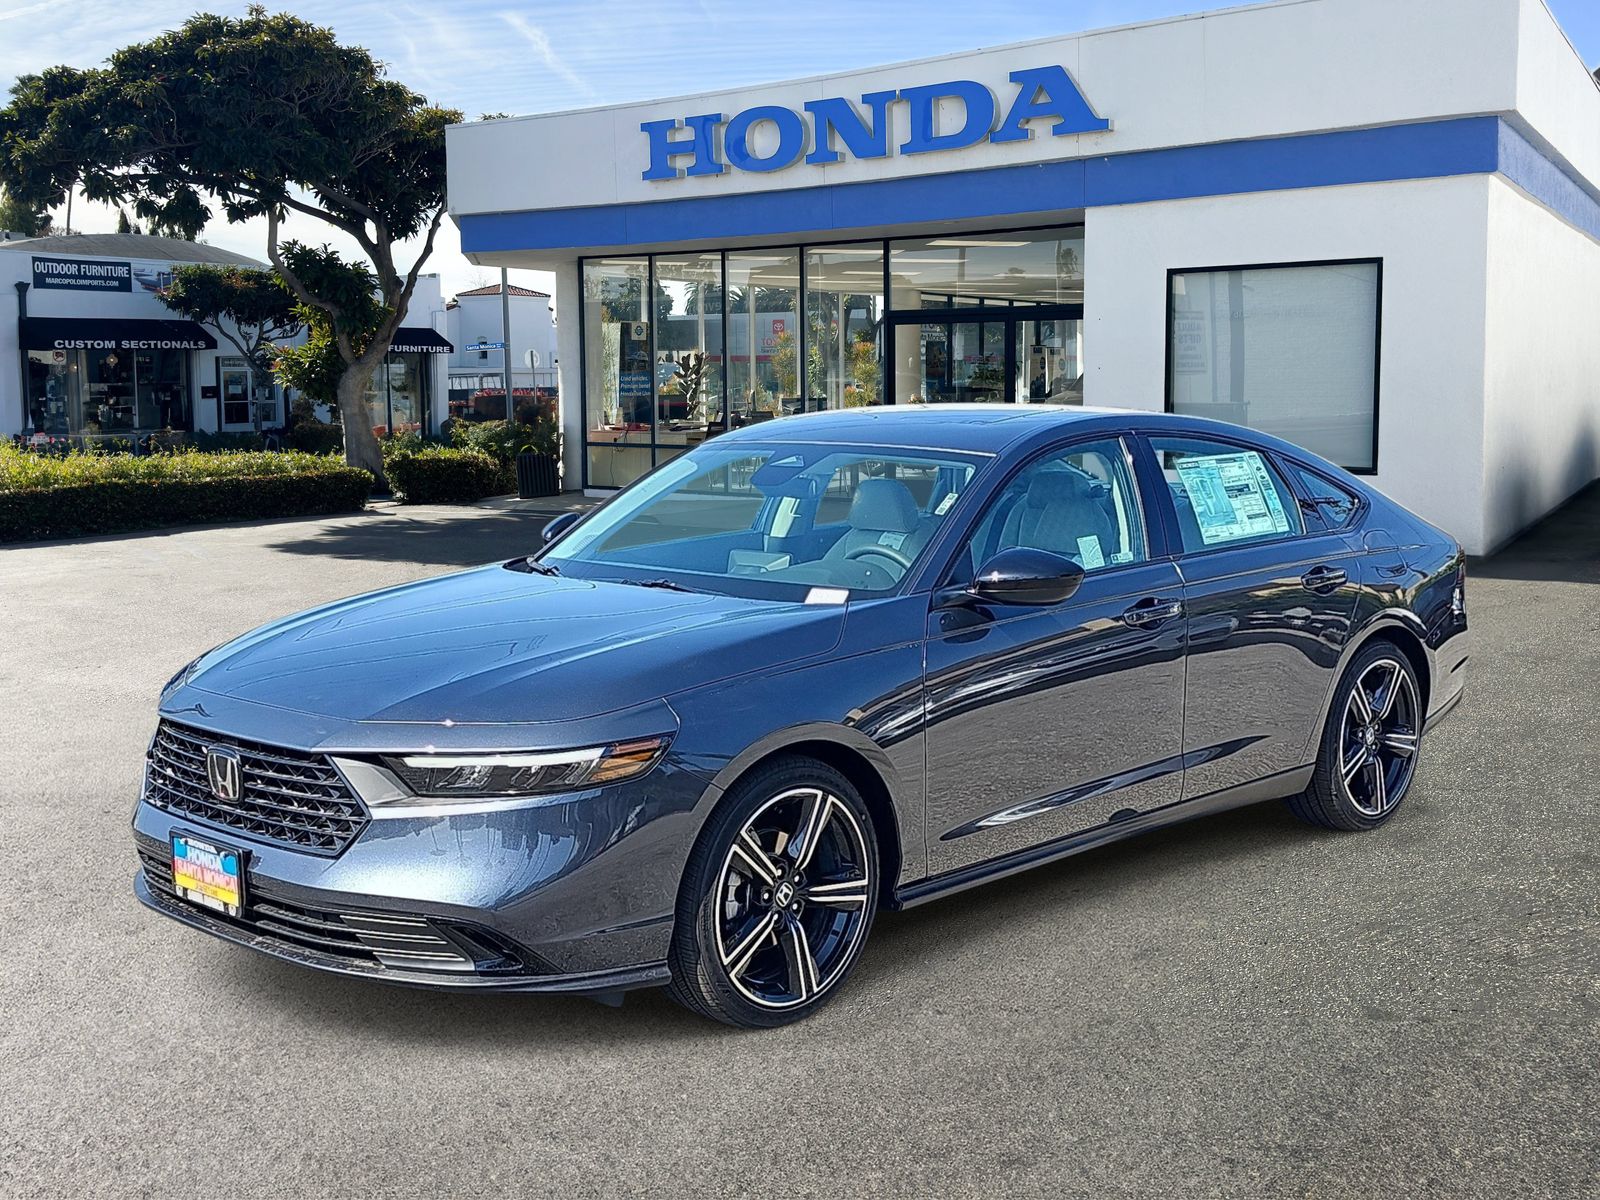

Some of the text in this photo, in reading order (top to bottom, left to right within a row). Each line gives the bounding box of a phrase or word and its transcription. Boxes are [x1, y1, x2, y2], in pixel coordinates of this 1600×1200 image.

[640, 65, 1112, 181] HONDA
[34, 261, 130, 278] OUTDOOR FURNITURE
[45, 277, 119, 287] MARCOPOLOIMPORTS.COM
[54, 339, 206, 349] CUSTOM SECTIONALS
[387, 344, 450, 353] FURNITURE
[187, 845, 223, 873] HONDA
[176, 858, 205, 883] SANTA
